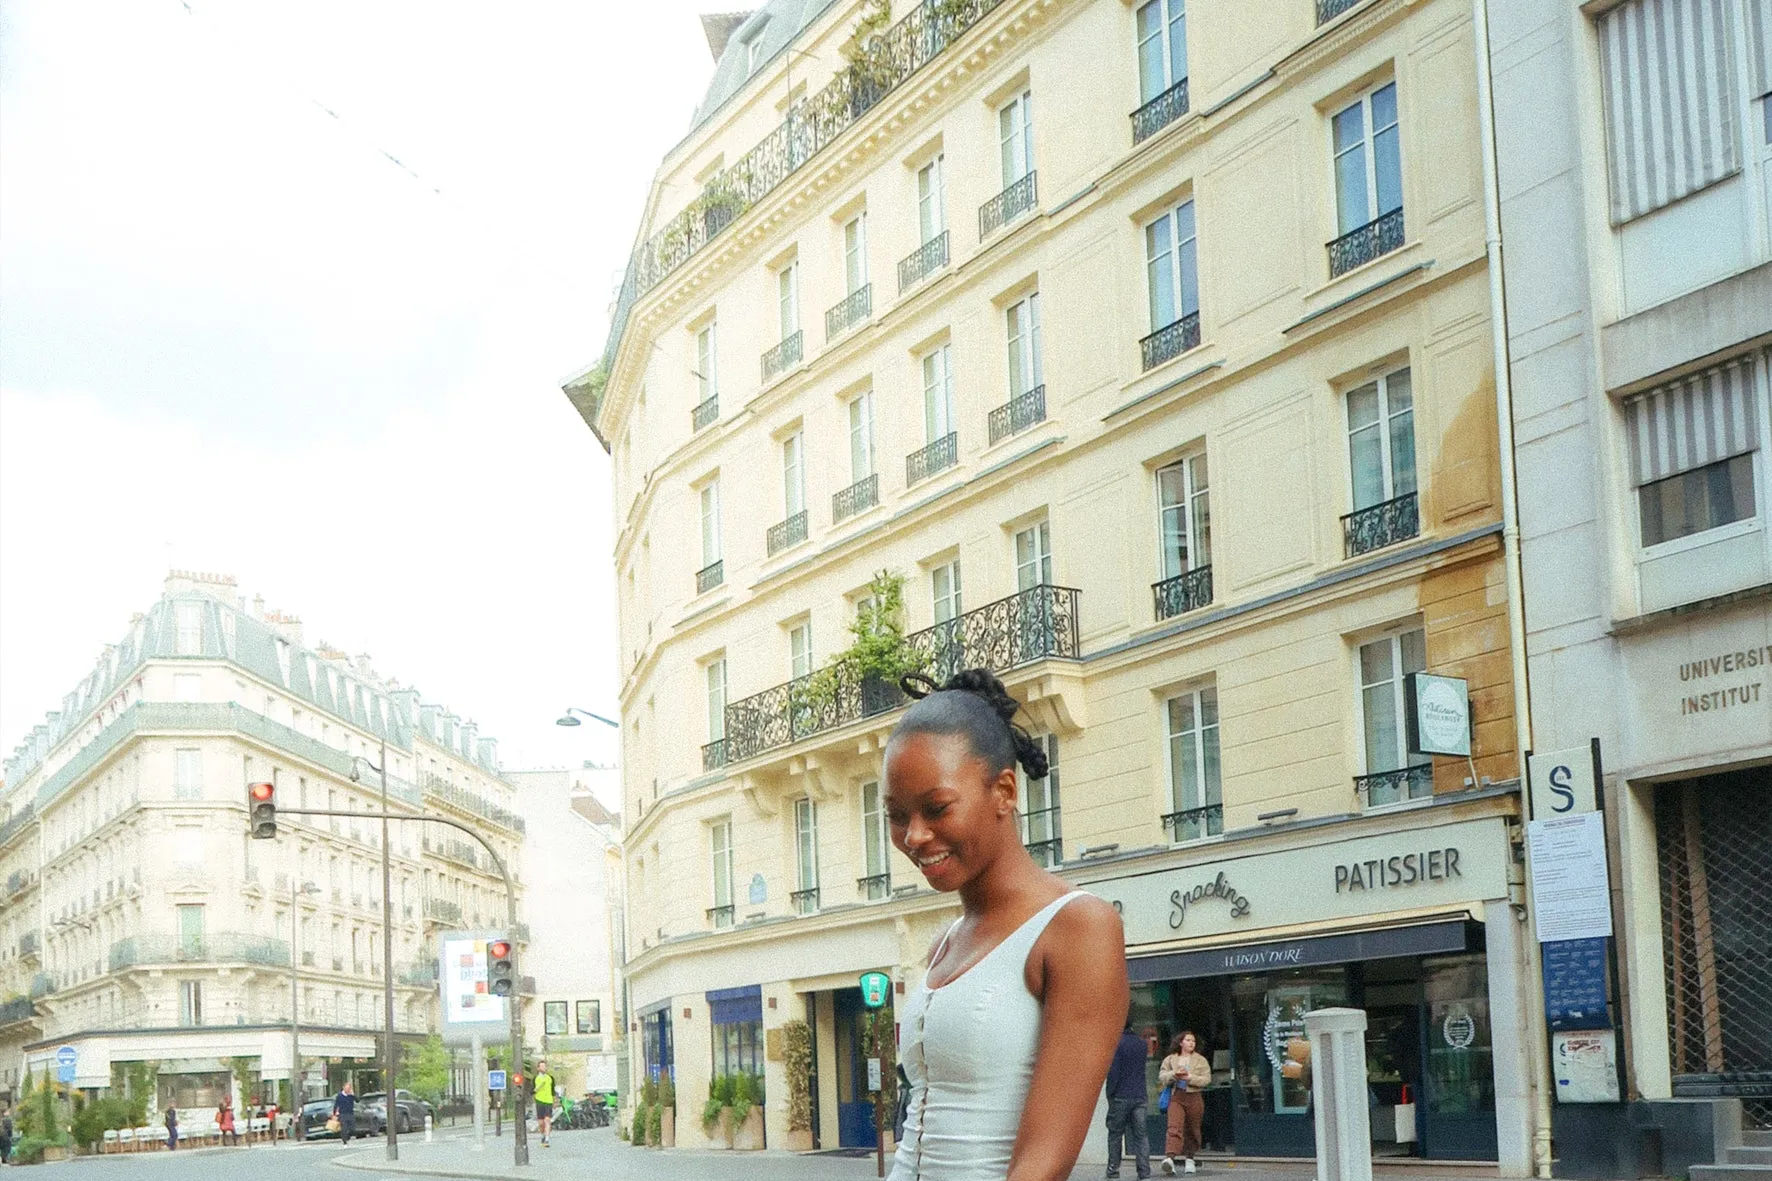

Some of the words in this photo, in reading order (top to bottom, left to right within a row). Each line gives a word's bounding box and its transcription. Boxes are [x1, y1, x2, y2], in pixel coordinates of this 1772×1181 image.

[1681, 682, 1762, 716] INSTITUT
[1334, 847, 1462, 893] PATISSIER
[1169, 871, 1250, 929] Snacking
